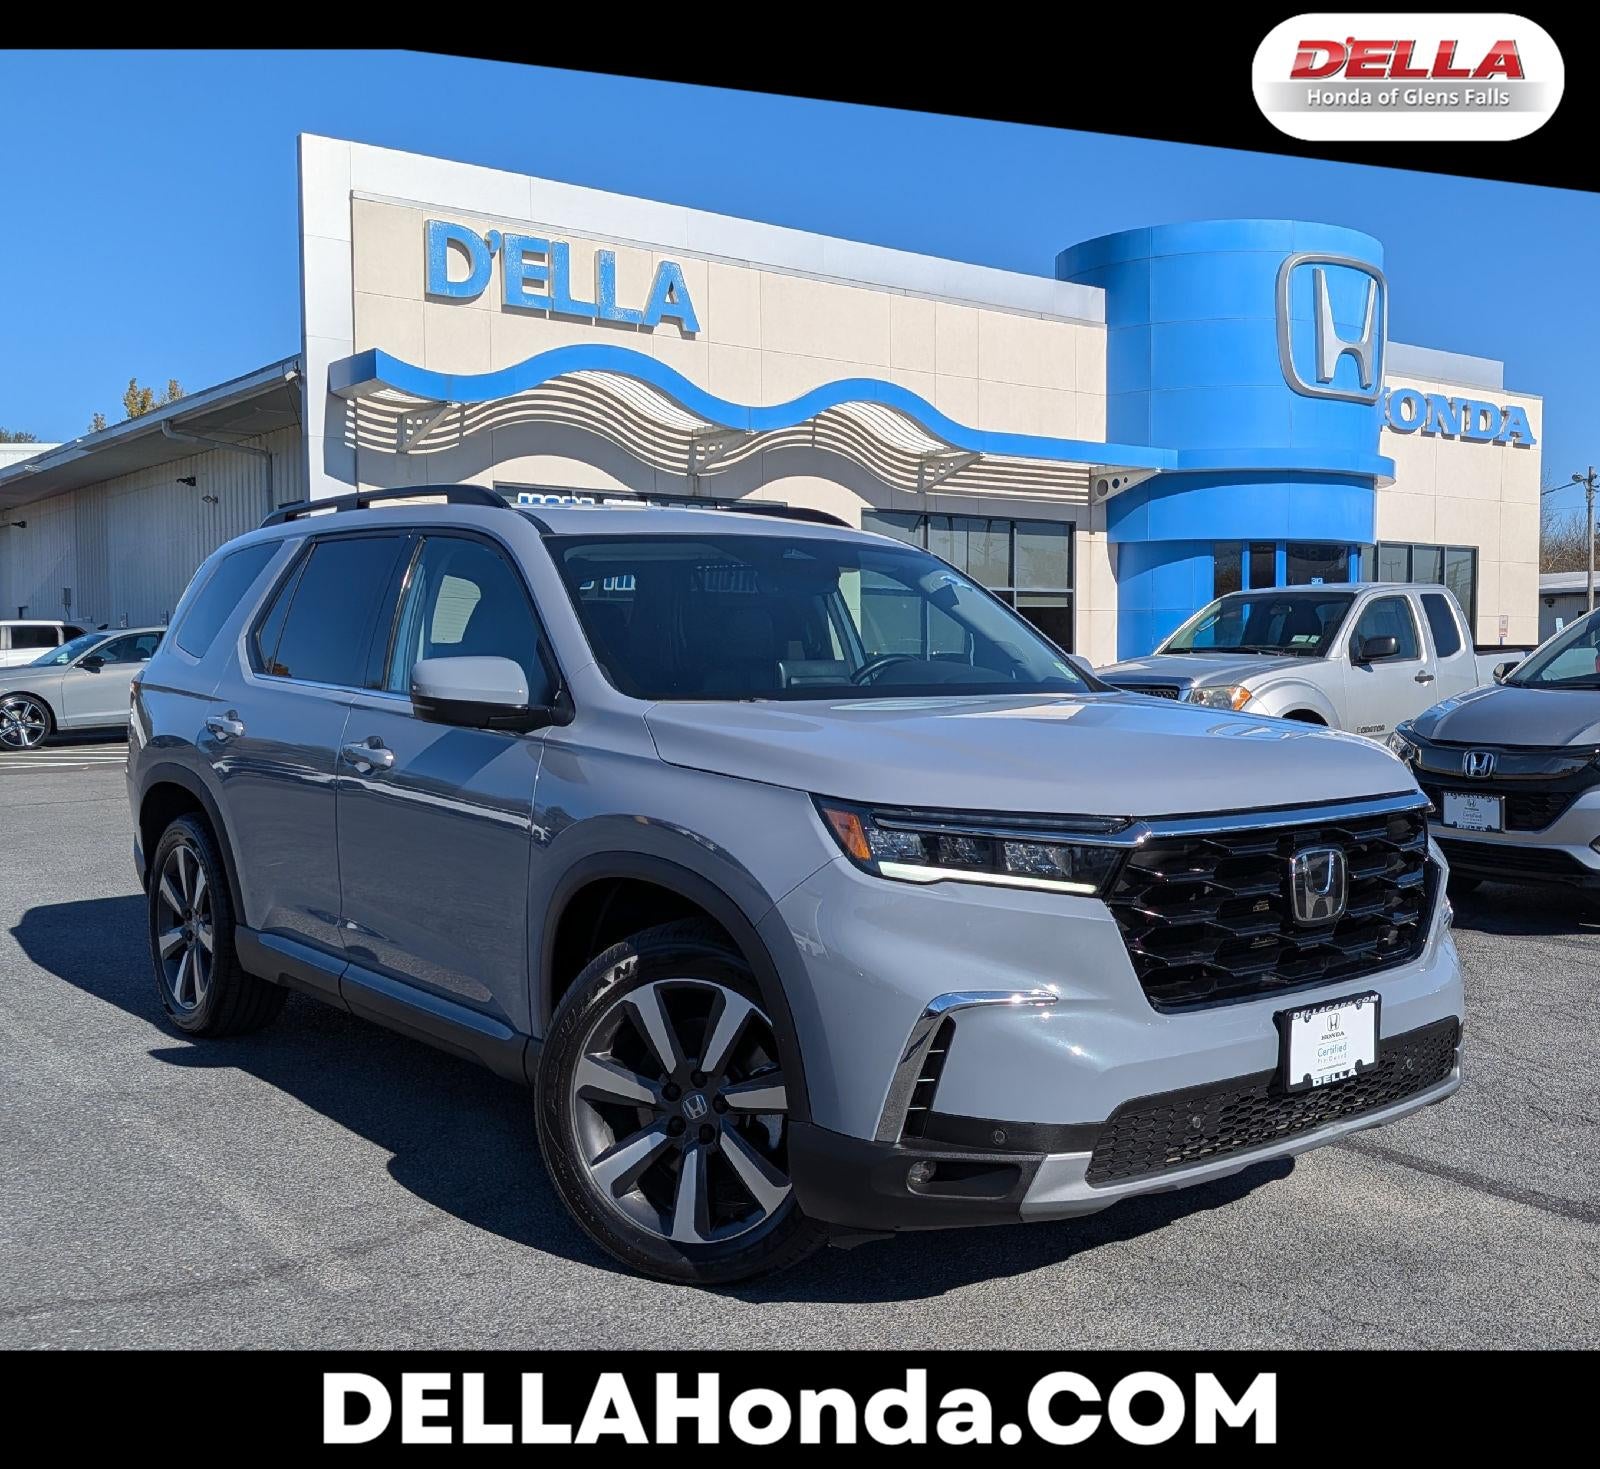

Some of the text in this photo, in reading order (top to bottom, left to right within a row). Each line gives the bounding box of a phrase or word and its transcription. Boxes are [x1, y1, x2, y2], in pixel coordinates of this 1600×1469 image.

[424, 219, 701, 336] D'ELLA
[1380, 386, 1537, 446] ONDA
[1320, 1030, 1345, 1041] HONDA
[1317, 1042, 1348, 1058] Certified
[1312, 1068, 1358, 1087] DELLA
